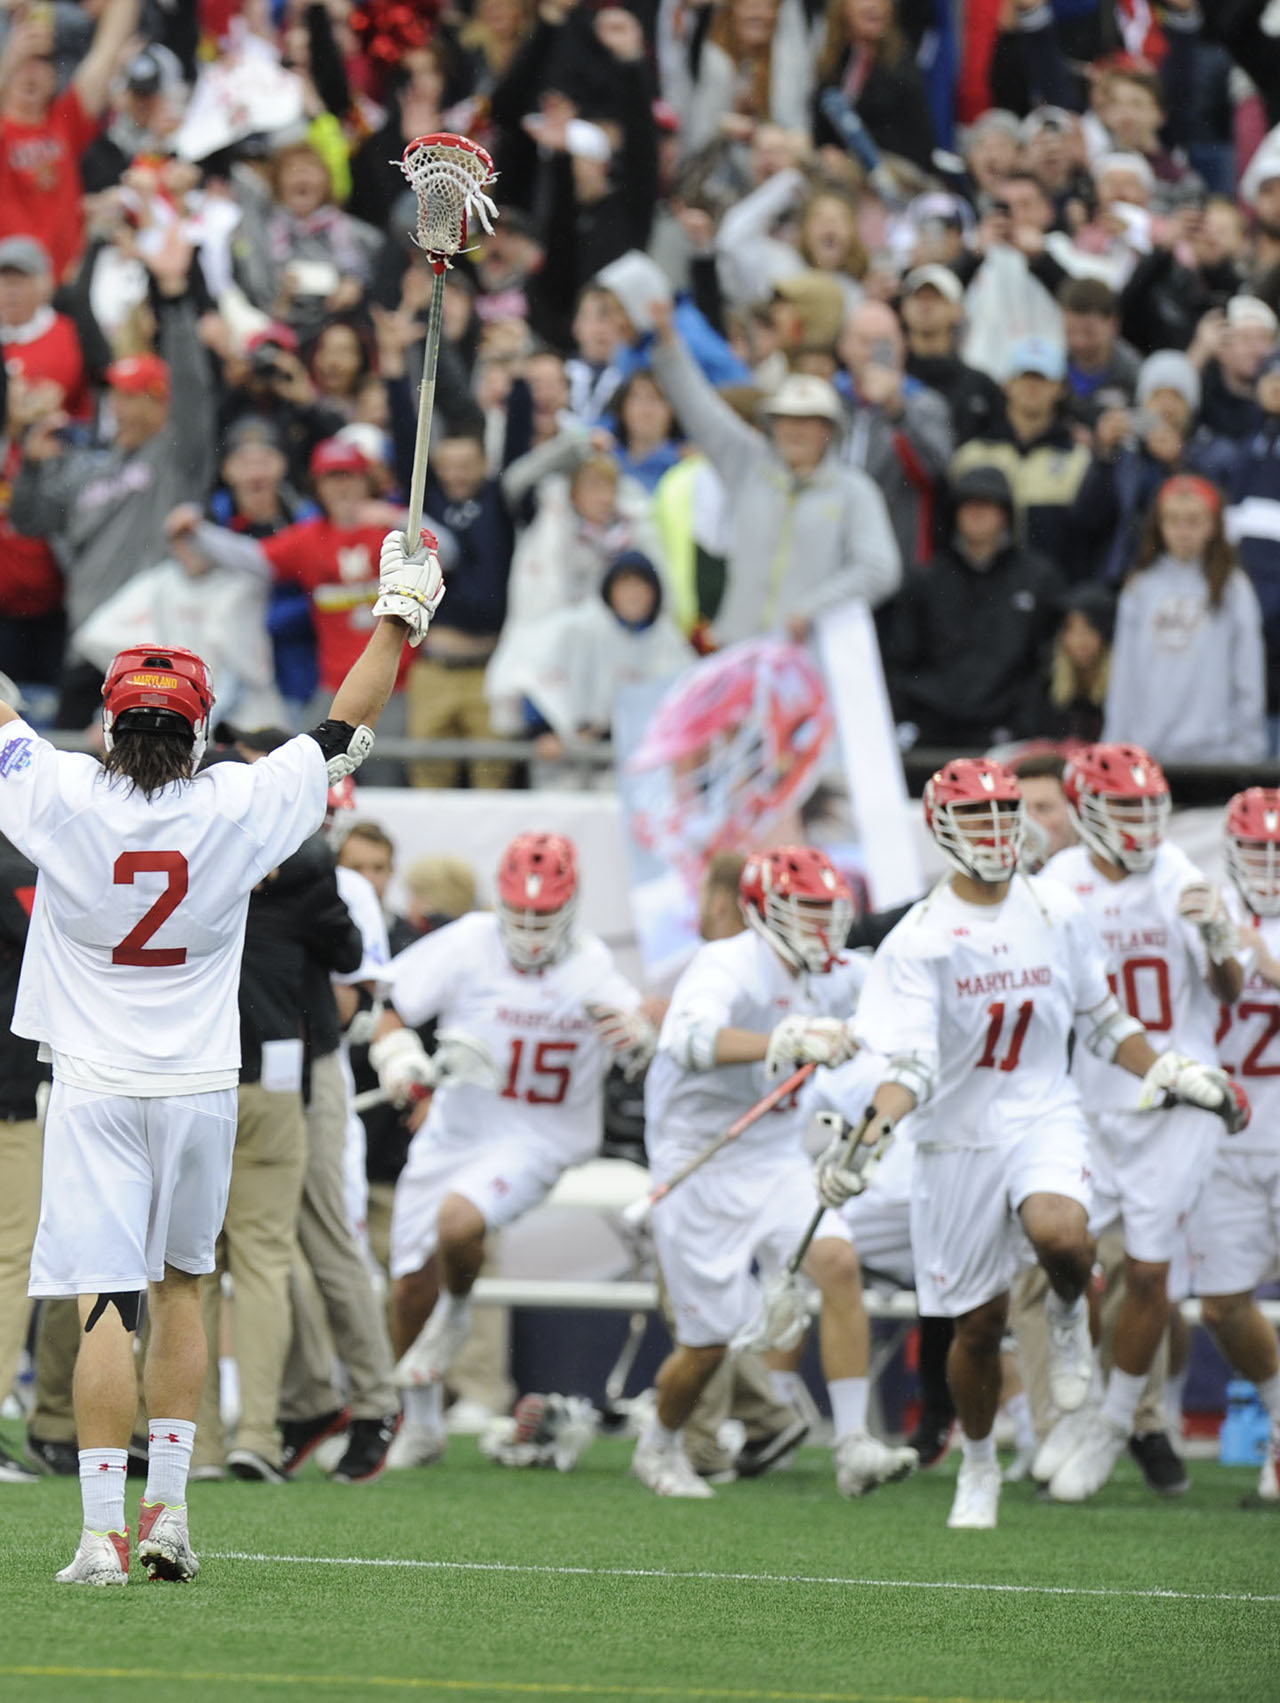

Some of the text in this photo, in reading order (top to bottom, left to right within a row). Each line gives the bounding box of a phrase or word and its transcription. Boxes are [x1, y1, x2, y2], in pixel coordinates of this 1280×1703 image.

[133, 674, 178, 689] MARYLAND
[112, 849, 190, 967] 2
[956, 966, 1052, 998] MARYLAND
[975, 1000, 1034, 1072] 11
[500, 1038, 578, 1104] 15
